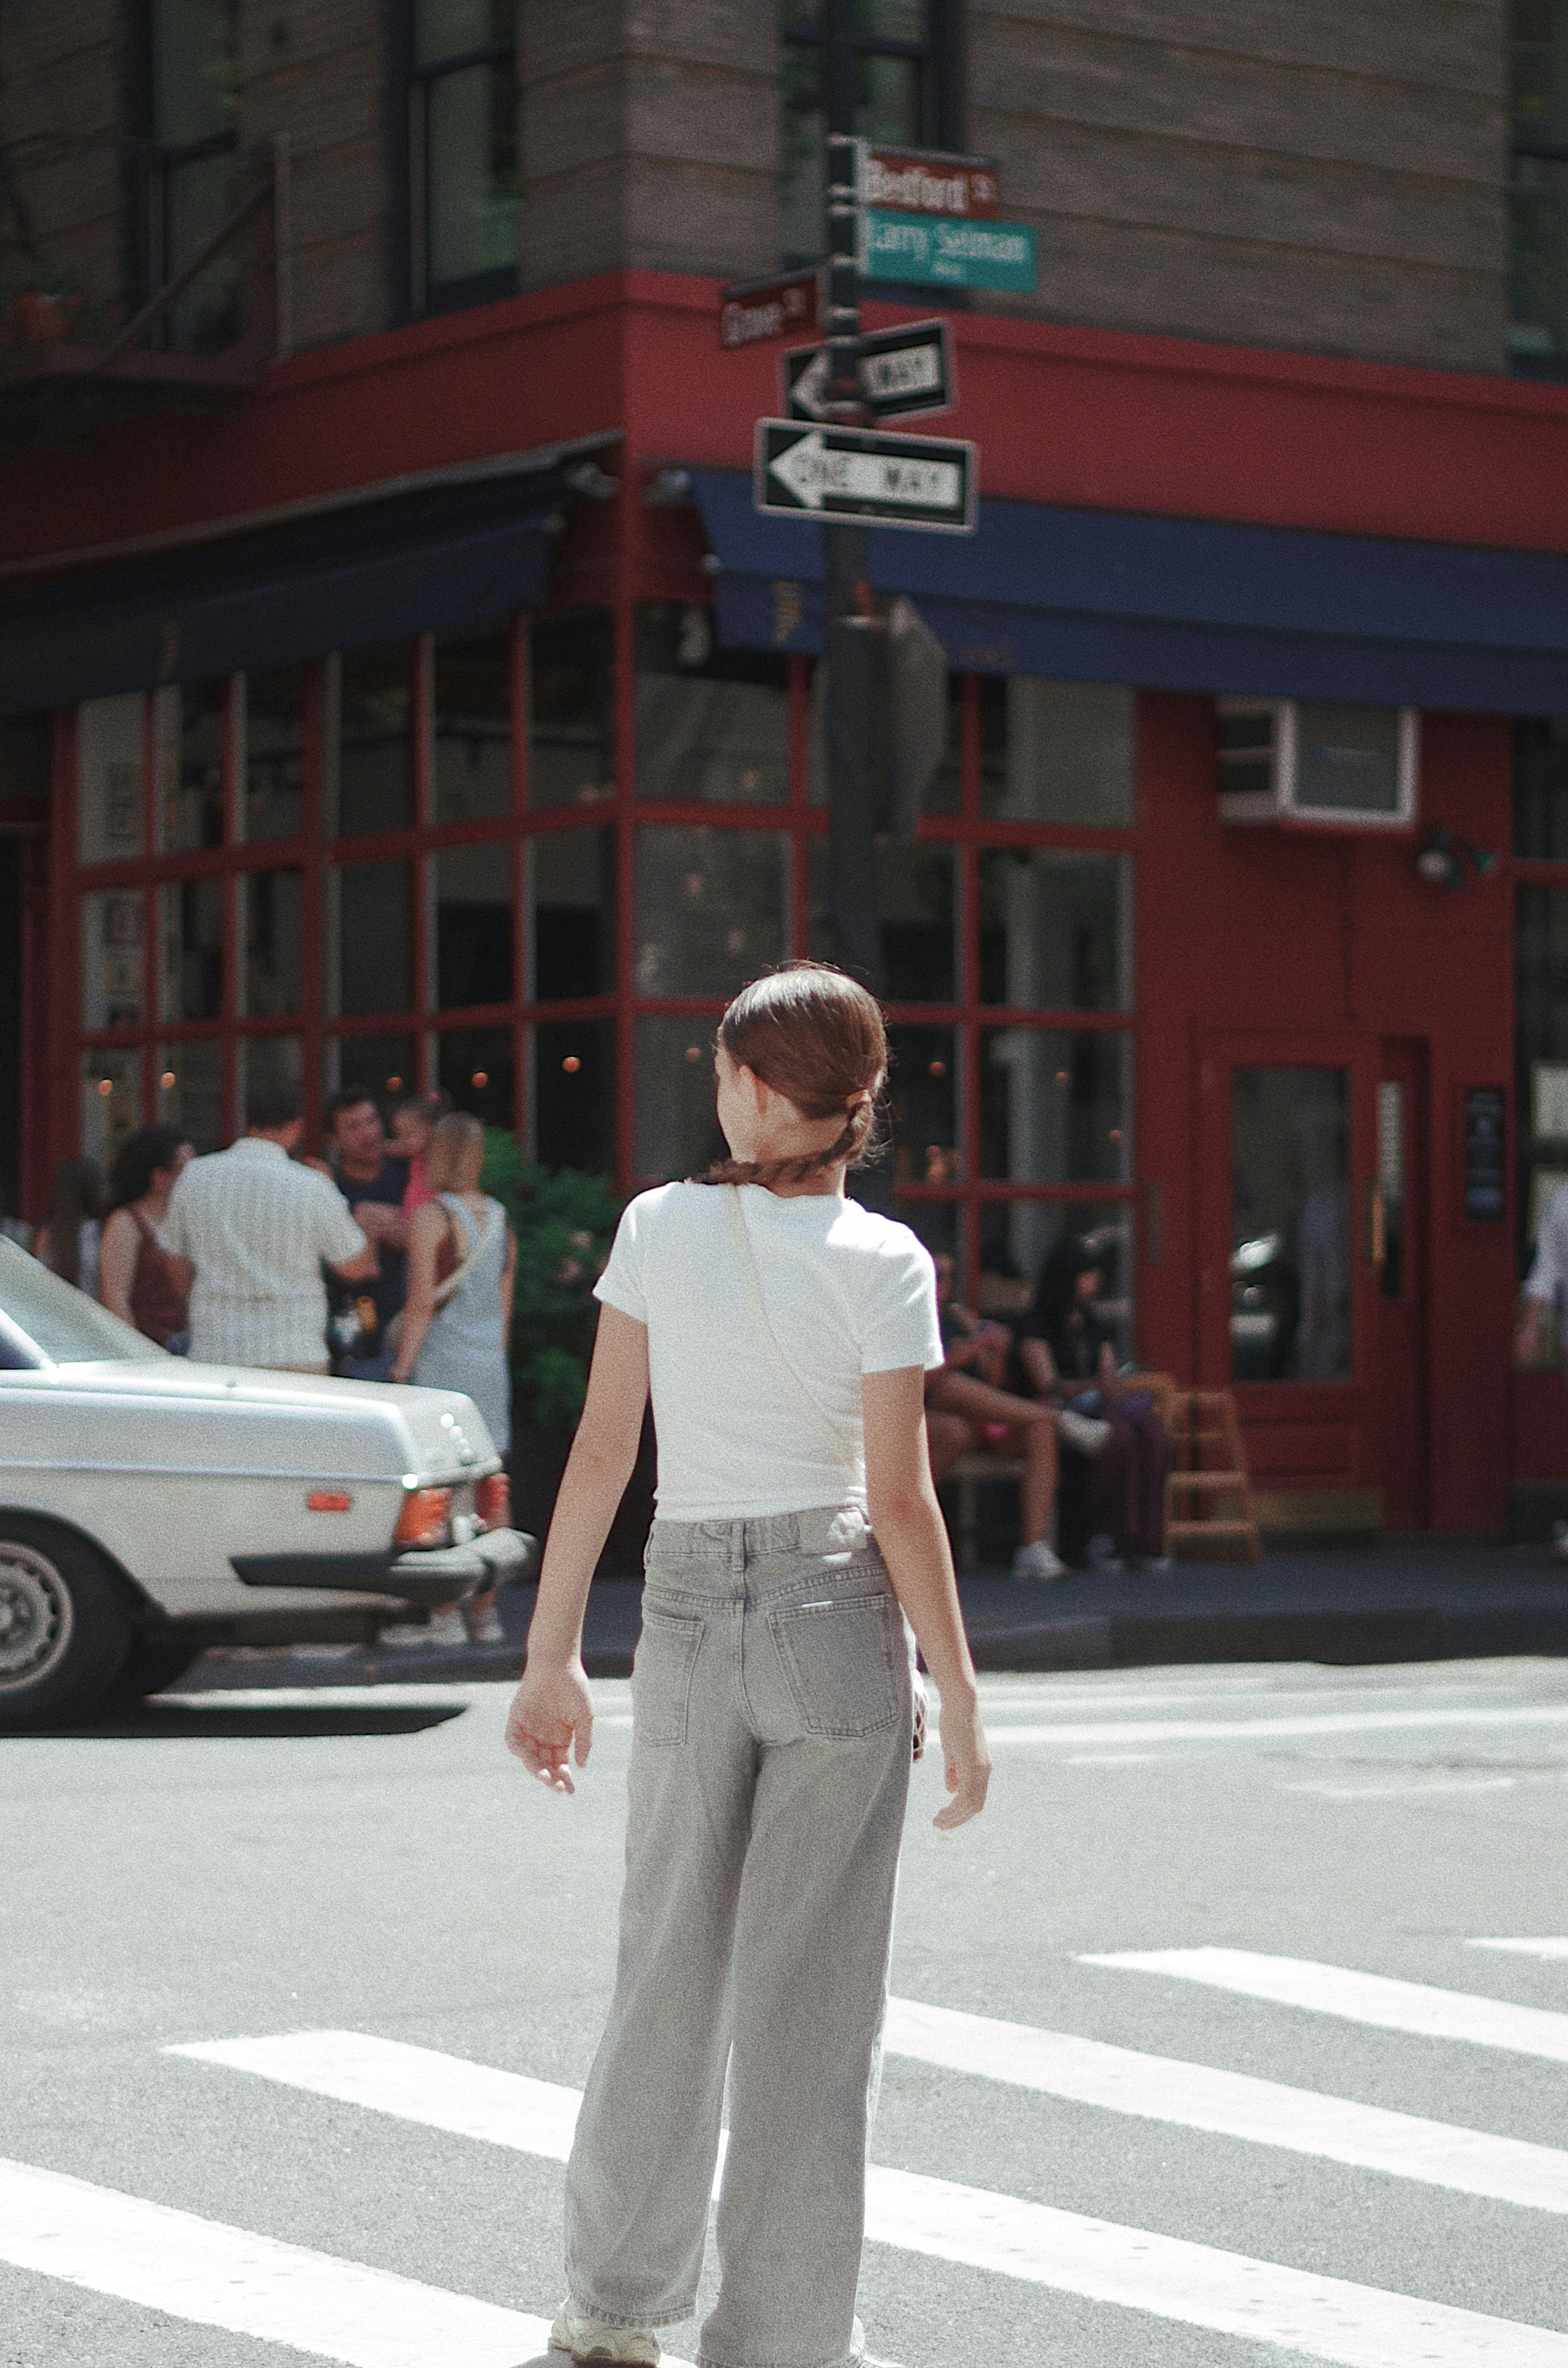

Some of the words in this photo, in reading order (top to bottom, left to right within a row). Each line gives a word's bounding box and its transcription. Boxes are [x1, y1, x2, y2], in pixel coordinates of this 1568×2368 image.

[866, 160, 967, 211] Bedford
[867, 216, 926, 260] Larry
[934, 223, 1027, 262] Selman
[877, 356, 924, 384] WAY
[793, 453, 851, 488] ONE
[884, 465, 941, 495] WAY
